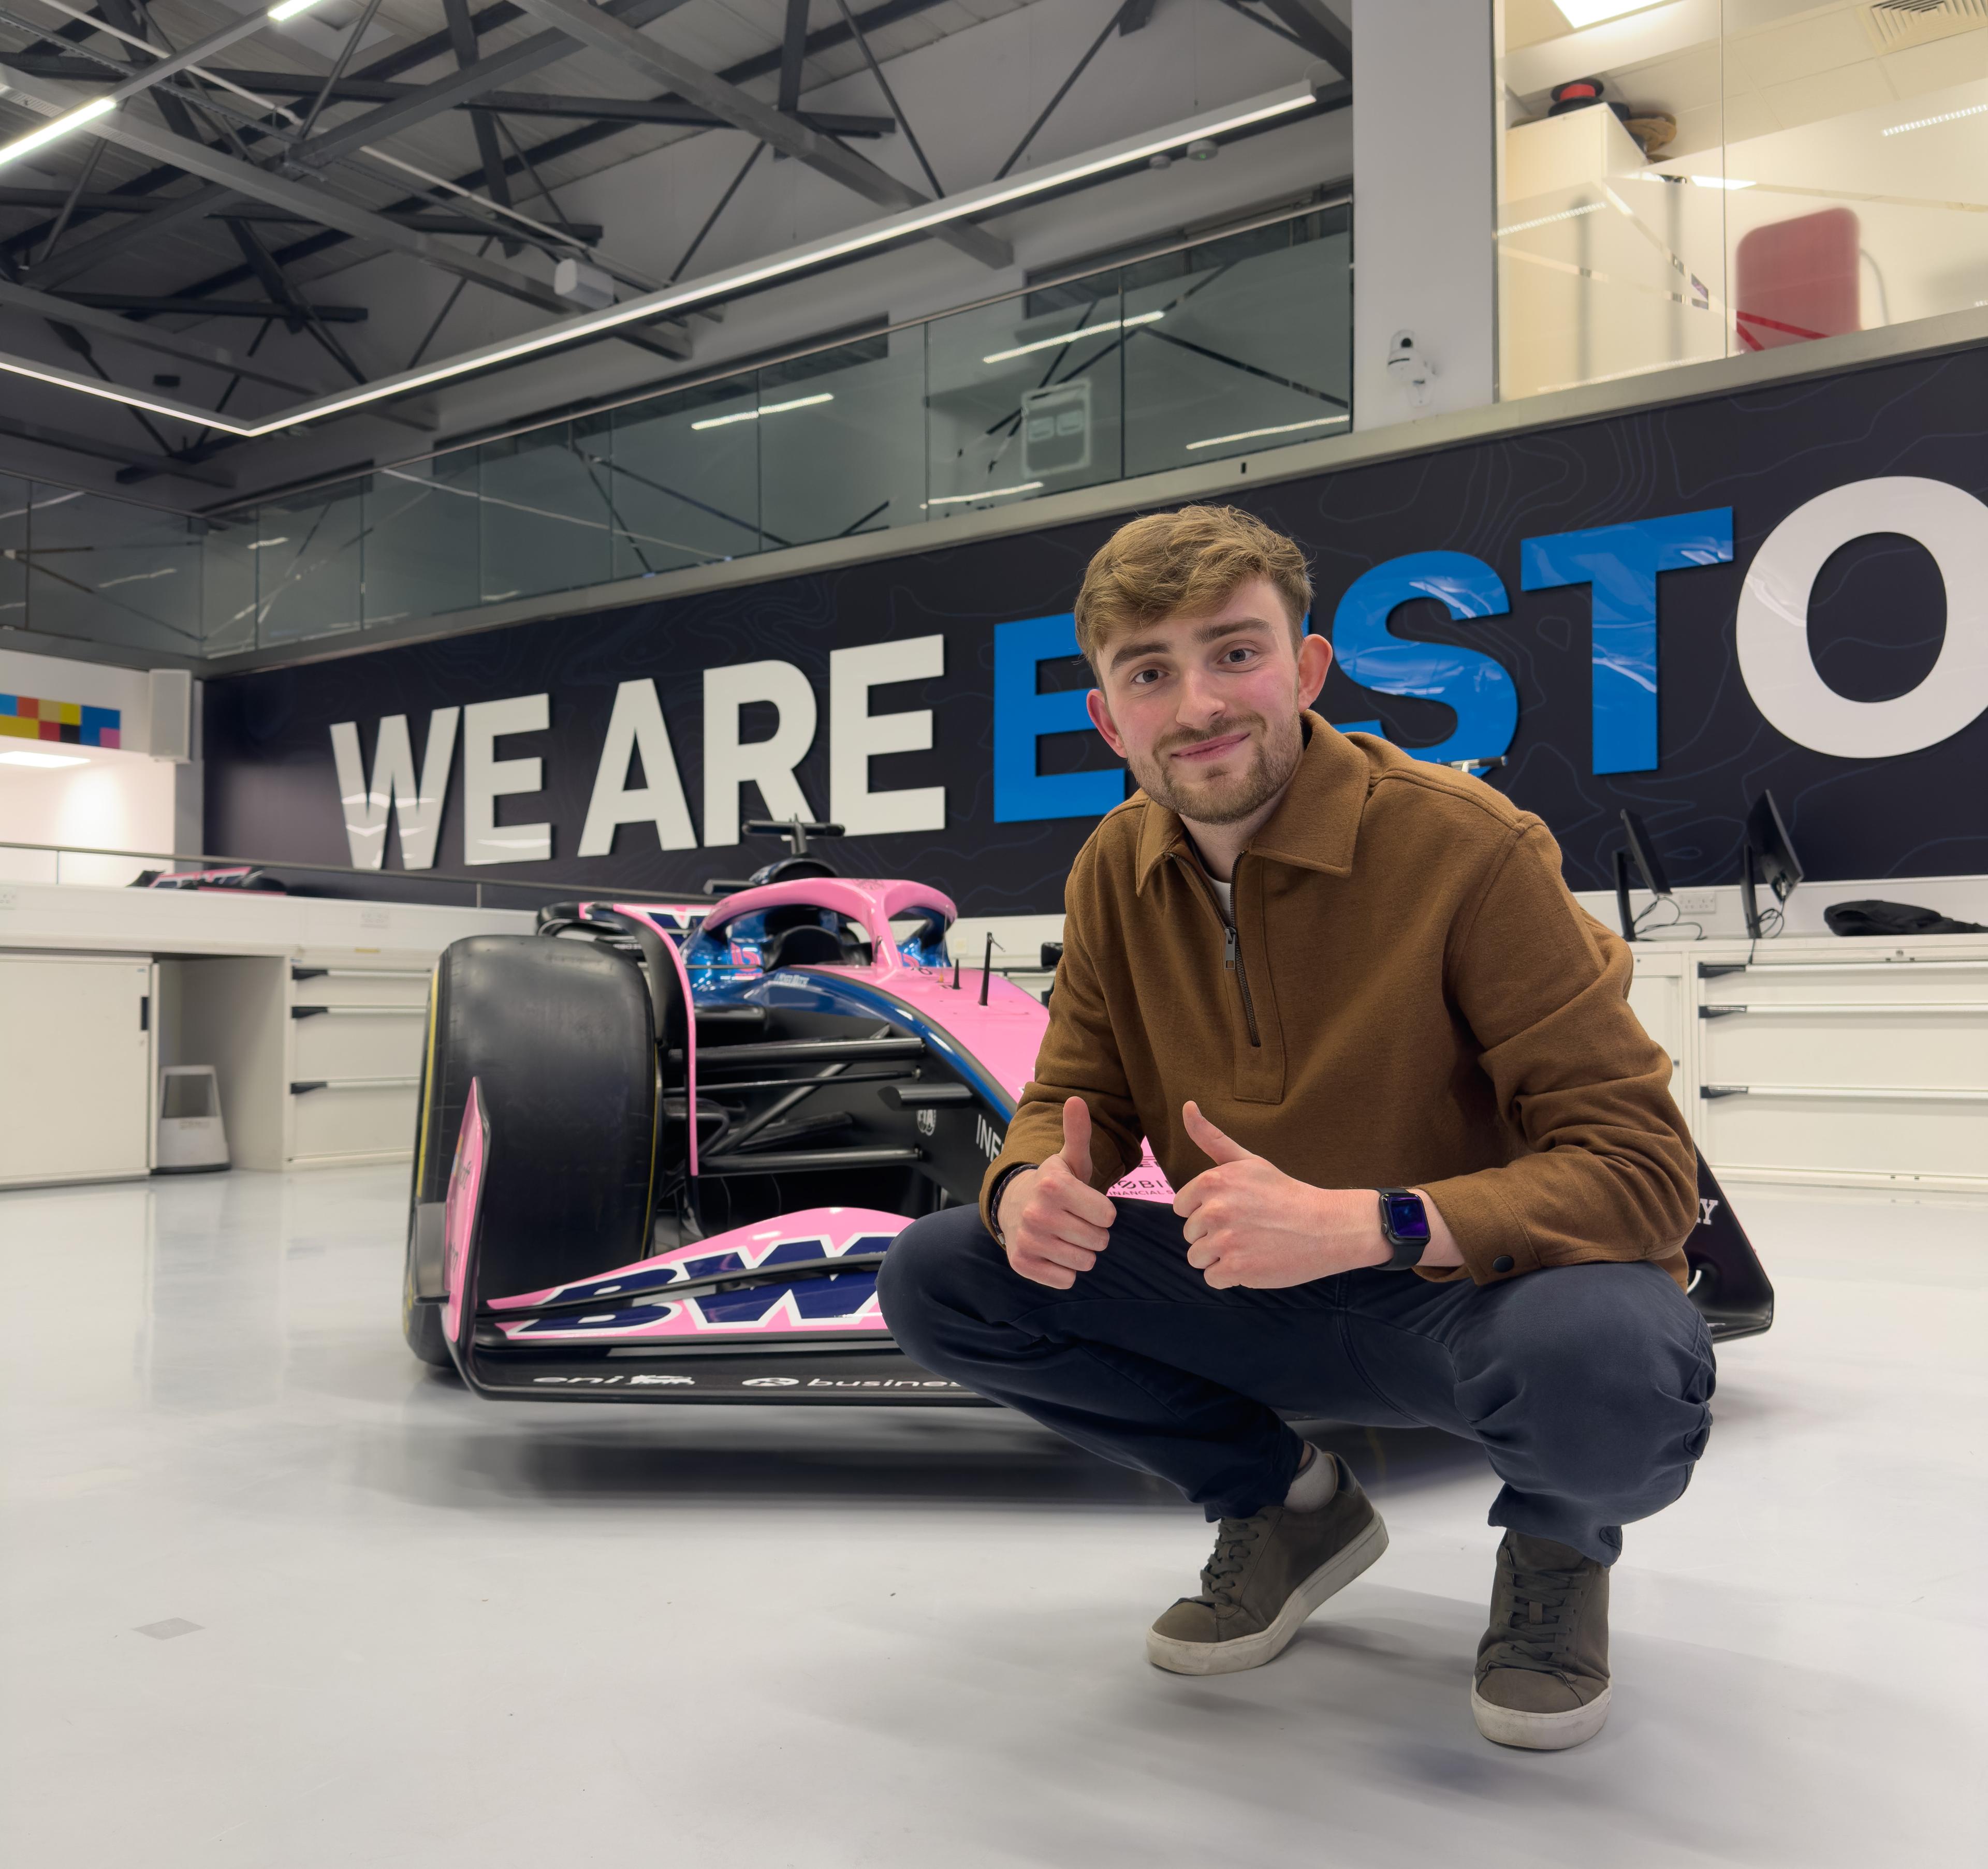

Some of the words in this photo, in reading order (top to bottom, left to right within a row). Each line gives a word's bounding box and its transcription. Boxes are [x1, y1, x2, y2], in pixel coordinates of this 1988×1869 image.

[330, 692, 552, 871] WE
[577, 634, 946, 857] ARE
[993, 476, 1988, 823] ESTO
